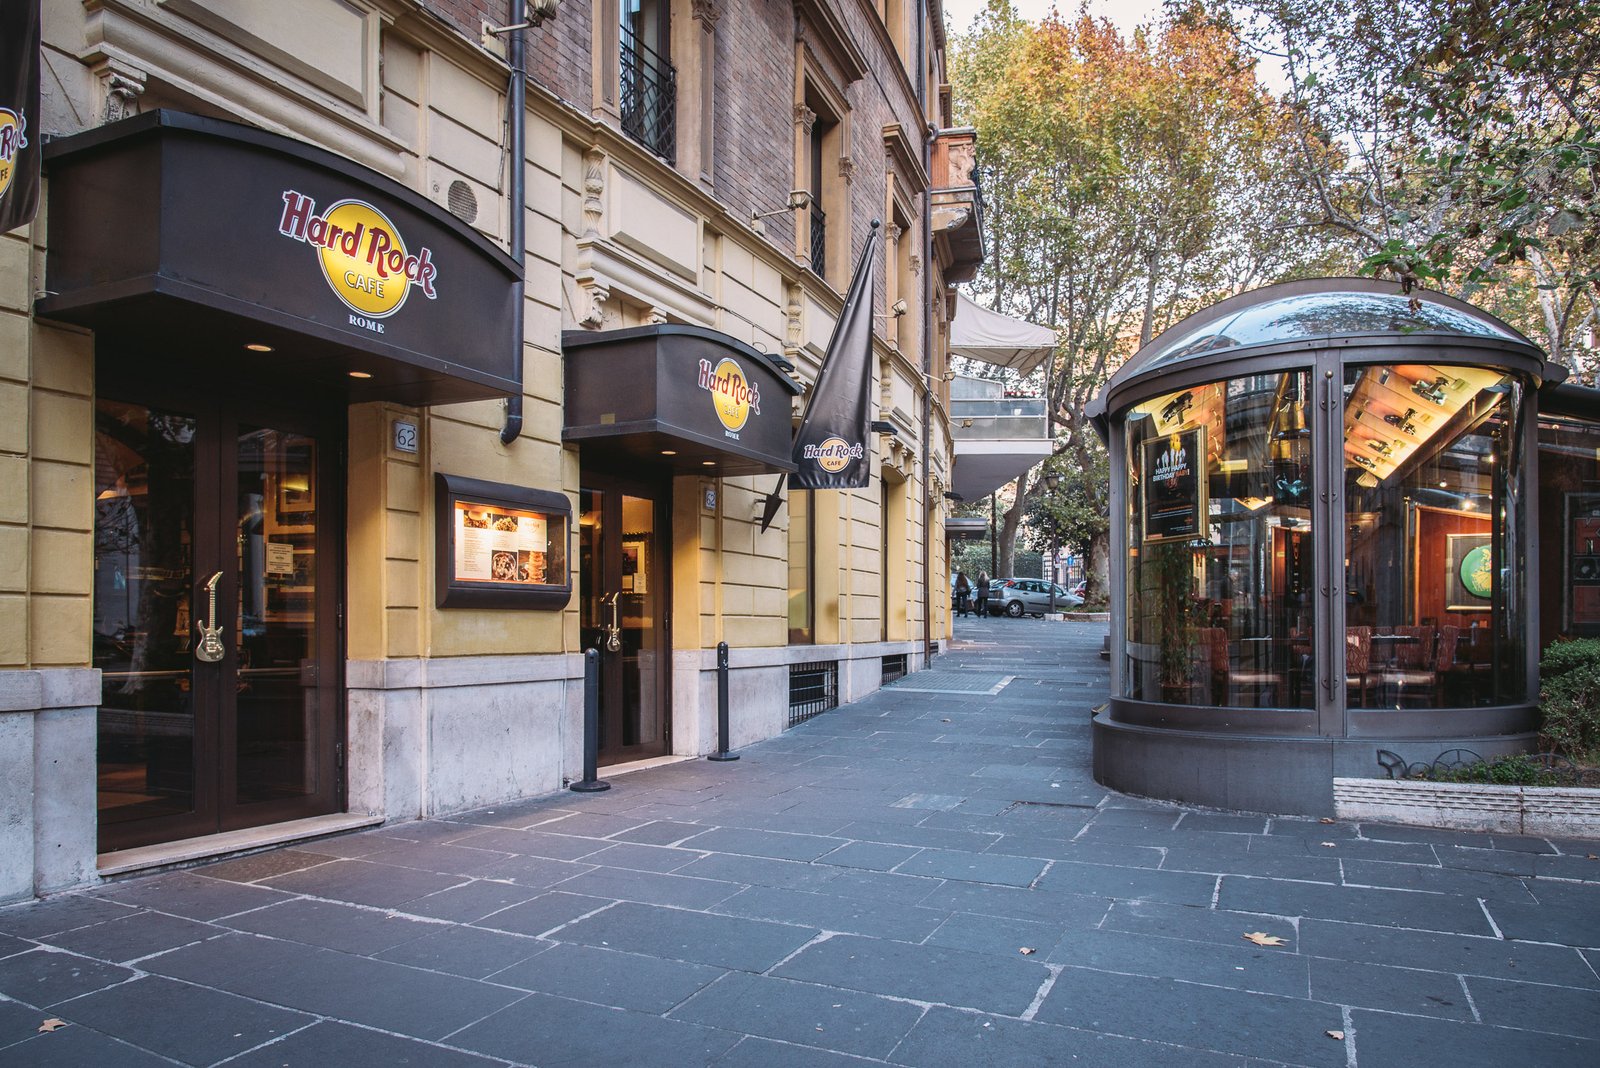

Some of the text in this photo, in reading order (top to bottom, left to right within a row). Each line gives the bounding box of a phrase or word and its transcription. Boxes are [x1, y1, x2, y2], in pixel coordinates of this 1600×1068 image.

[278, 189, 438, 300] Hard Rock
[344, 270, 385, 298] CAFE
[348, 314, 385, 334] ROME
[698, 358, 761, 416] Hard Rock
[723, 403, 740, 418] CAFE
[397, 428, 416, 447] 62
[803, 442, 864, 460] Hard Rock
[1152, 472, 1175, 481] BIRTHDAY
[1155, 463, 1187, 475] HAPPY HAPPY
